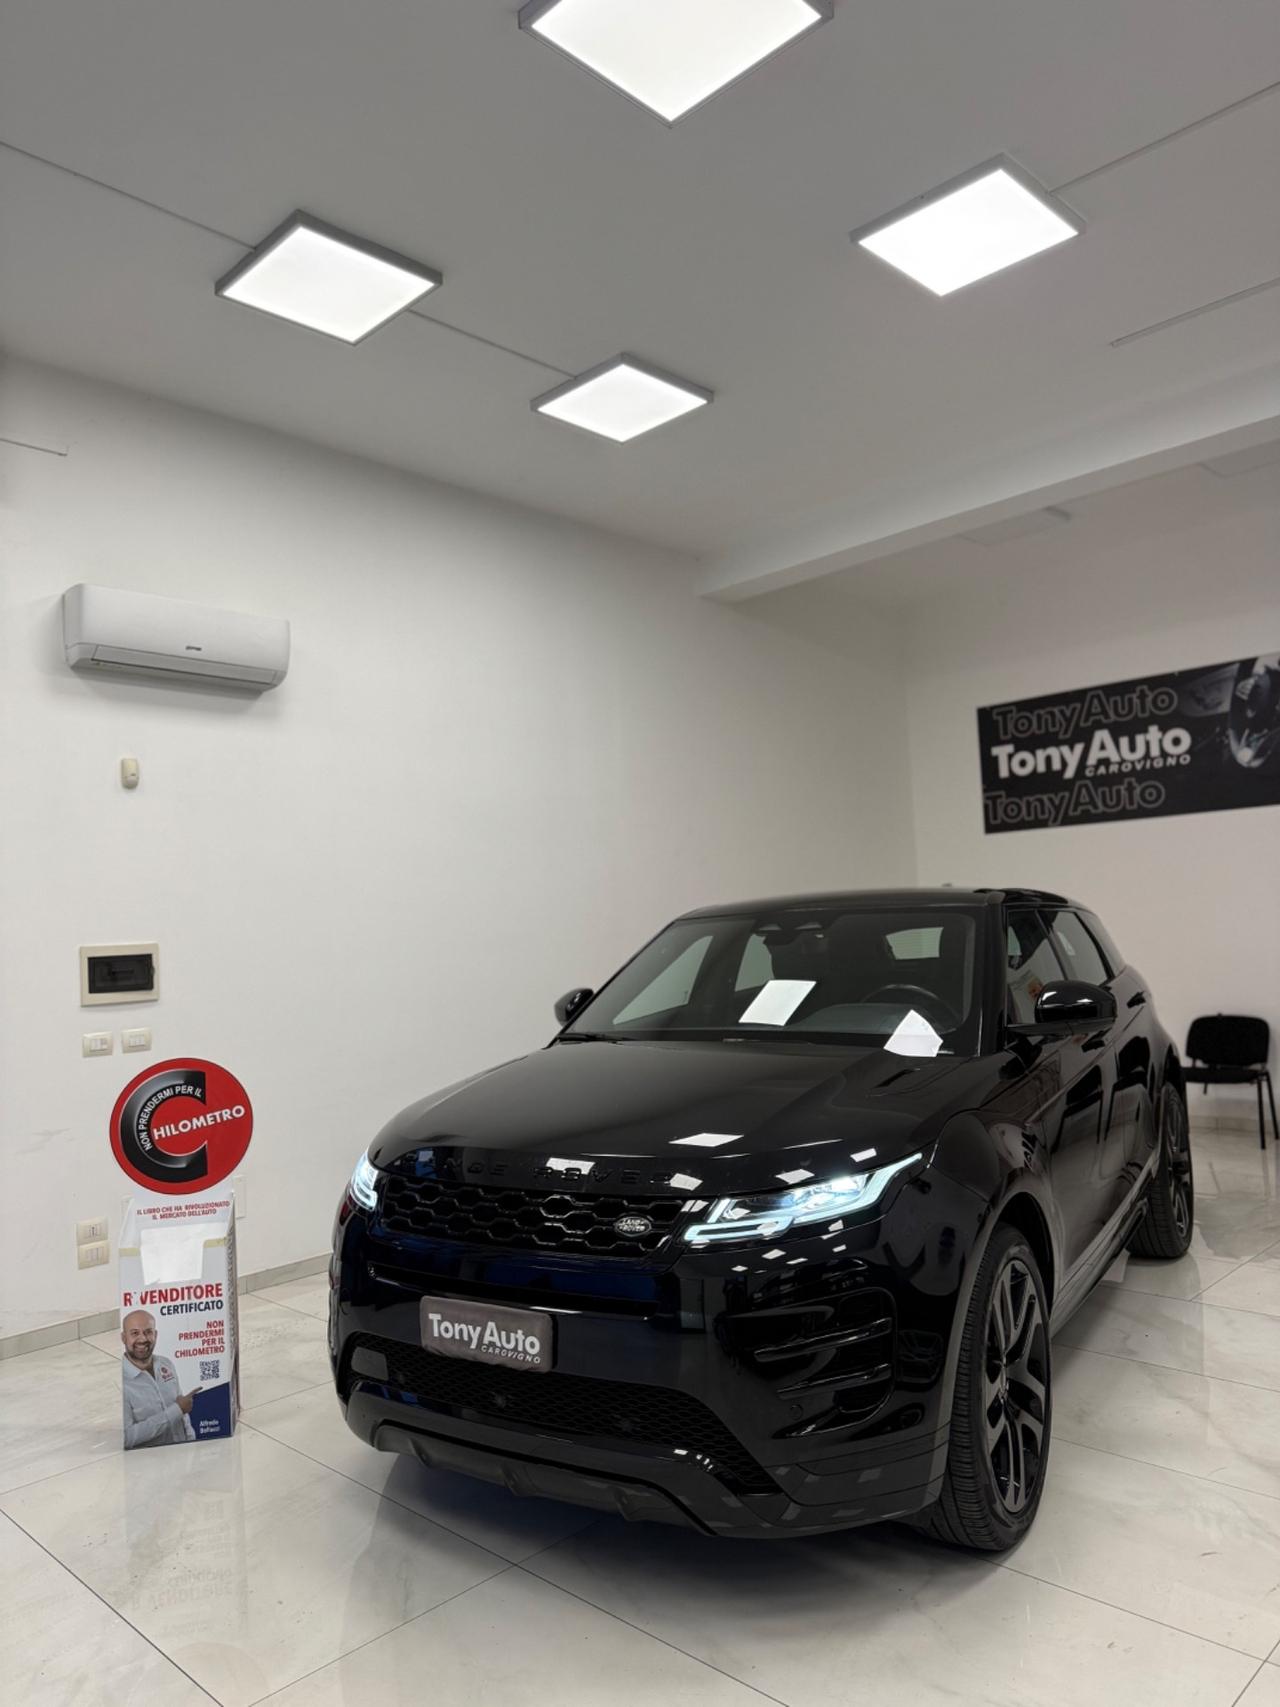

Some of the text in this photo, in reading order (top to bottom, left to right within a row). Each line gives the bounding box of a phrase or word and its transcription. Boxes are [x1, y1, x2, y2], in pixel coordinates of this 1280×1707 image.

[1085, 753, 1192, 777] CAROVIGNO
[138, 1085, 202, 1151] NON PRENDERMI PER IL
[160, 1211, 187, 1220] MERCATO
[161, 1206, 173, 1214] CHE
[123, 1283, 223, 1307] RVENDITORE
[160, 1300, 224, 1316] CERTIFICATO
[206, 1320, 224, 1329] NON
[179, 1329, 224, 1341] PRENDERMI
[201, 1337, 217, 1346] PER
[174, 1345, 225, 1358] CHILOMETRO
[481, 1345, 541, 1364] CAROVIGNO
